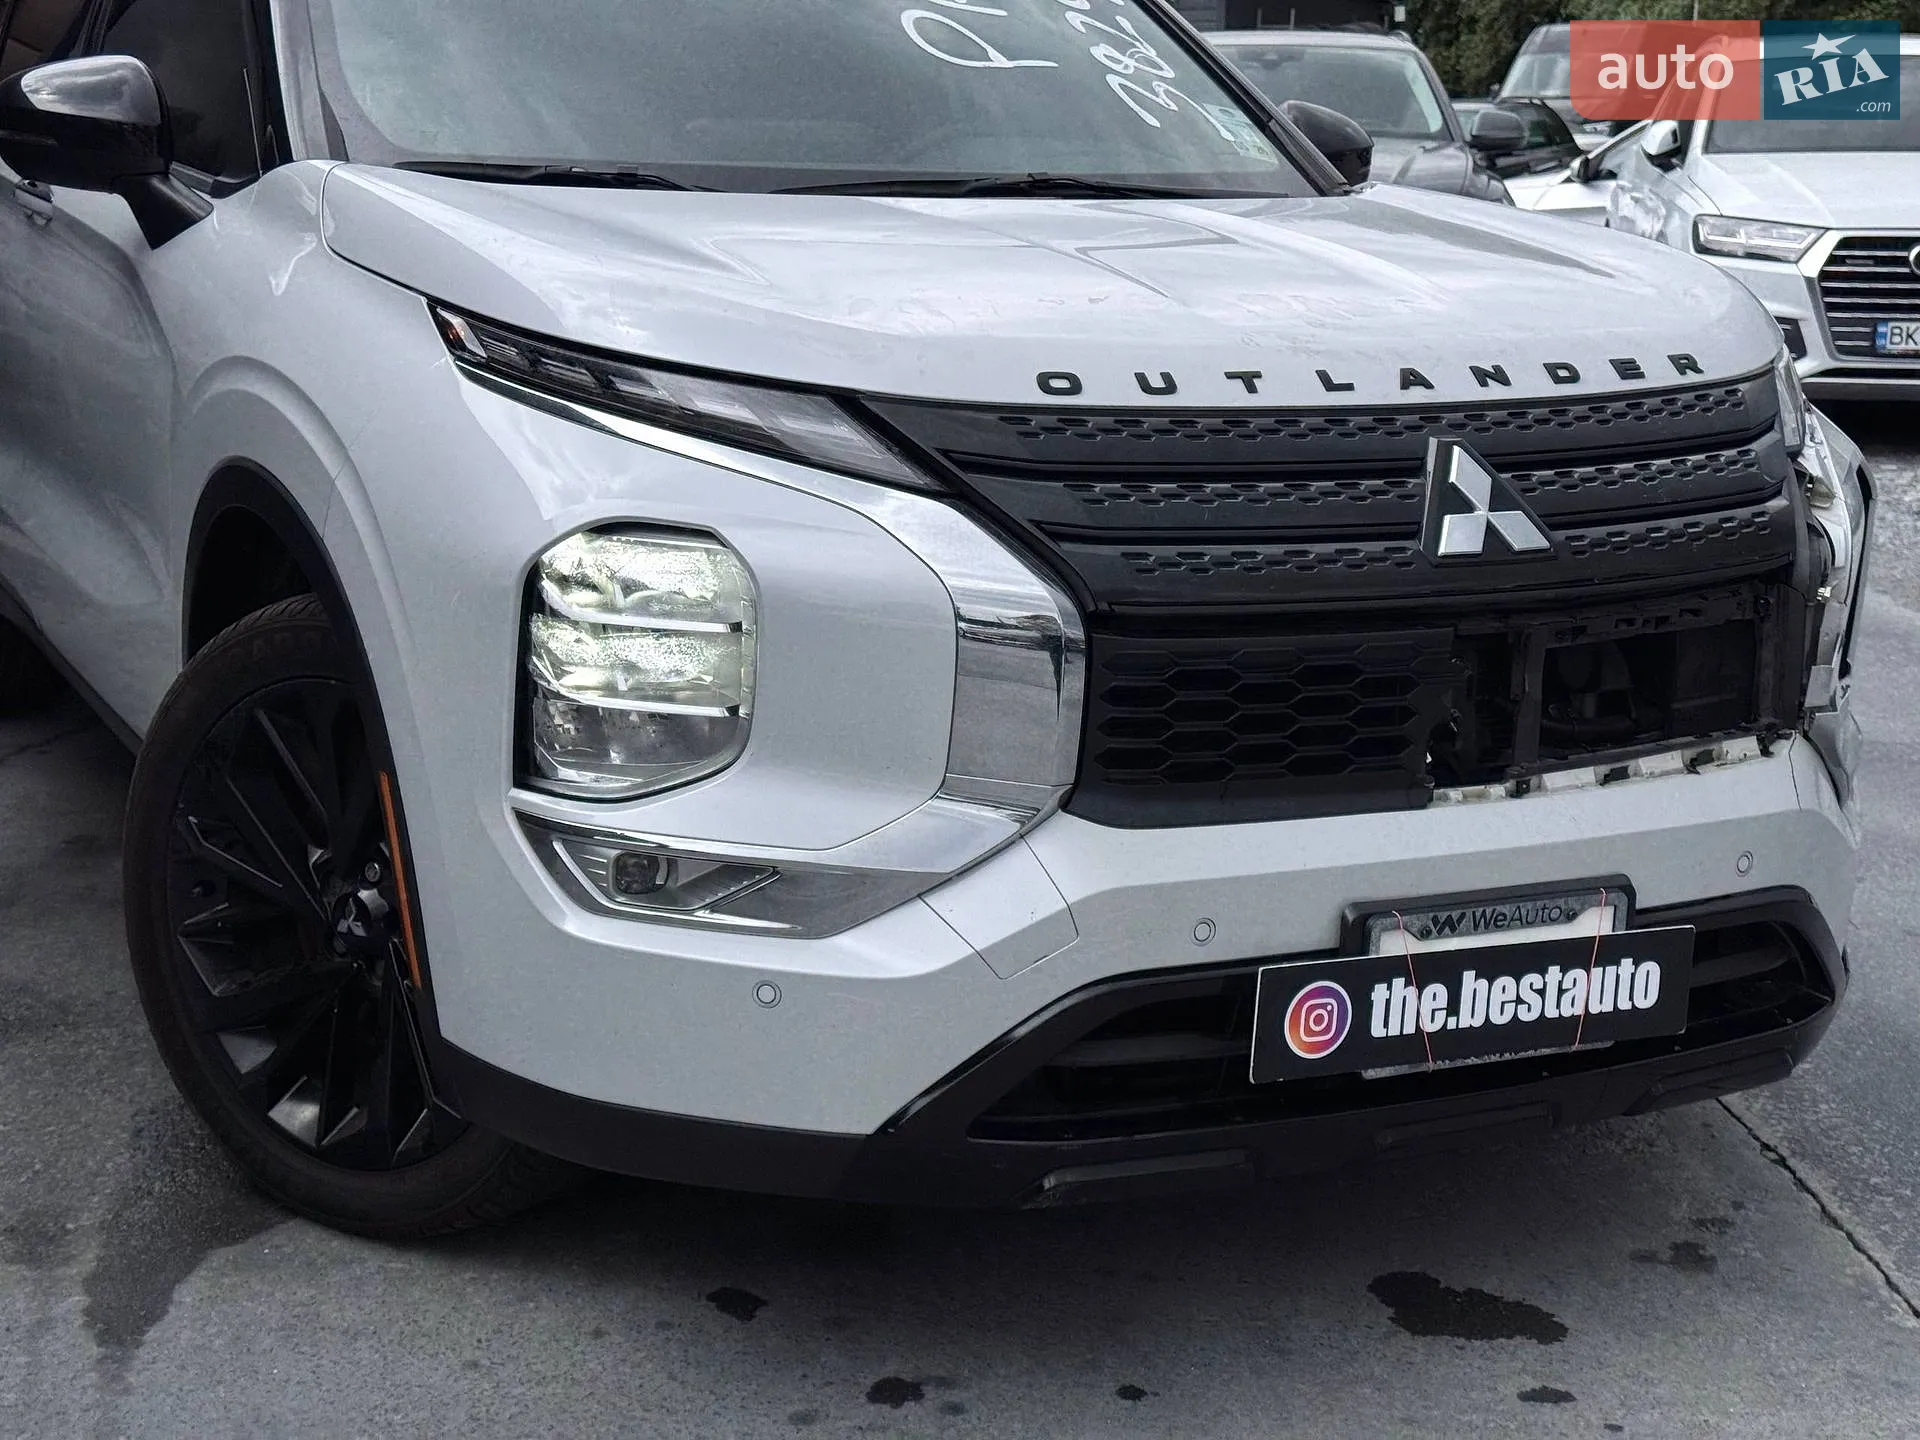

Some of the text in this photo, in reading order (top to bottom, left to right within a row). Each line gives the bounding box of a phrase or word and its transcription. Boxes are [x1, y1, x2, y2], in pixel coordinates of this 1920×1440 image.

[1889, 326, 1920, 346] BK
[1036, 353, 1705, 397] OUTLANDER
[1471, 905, 1563, 932] WeAuto
[1370, 958, 1661, 1039] the.bestauto
